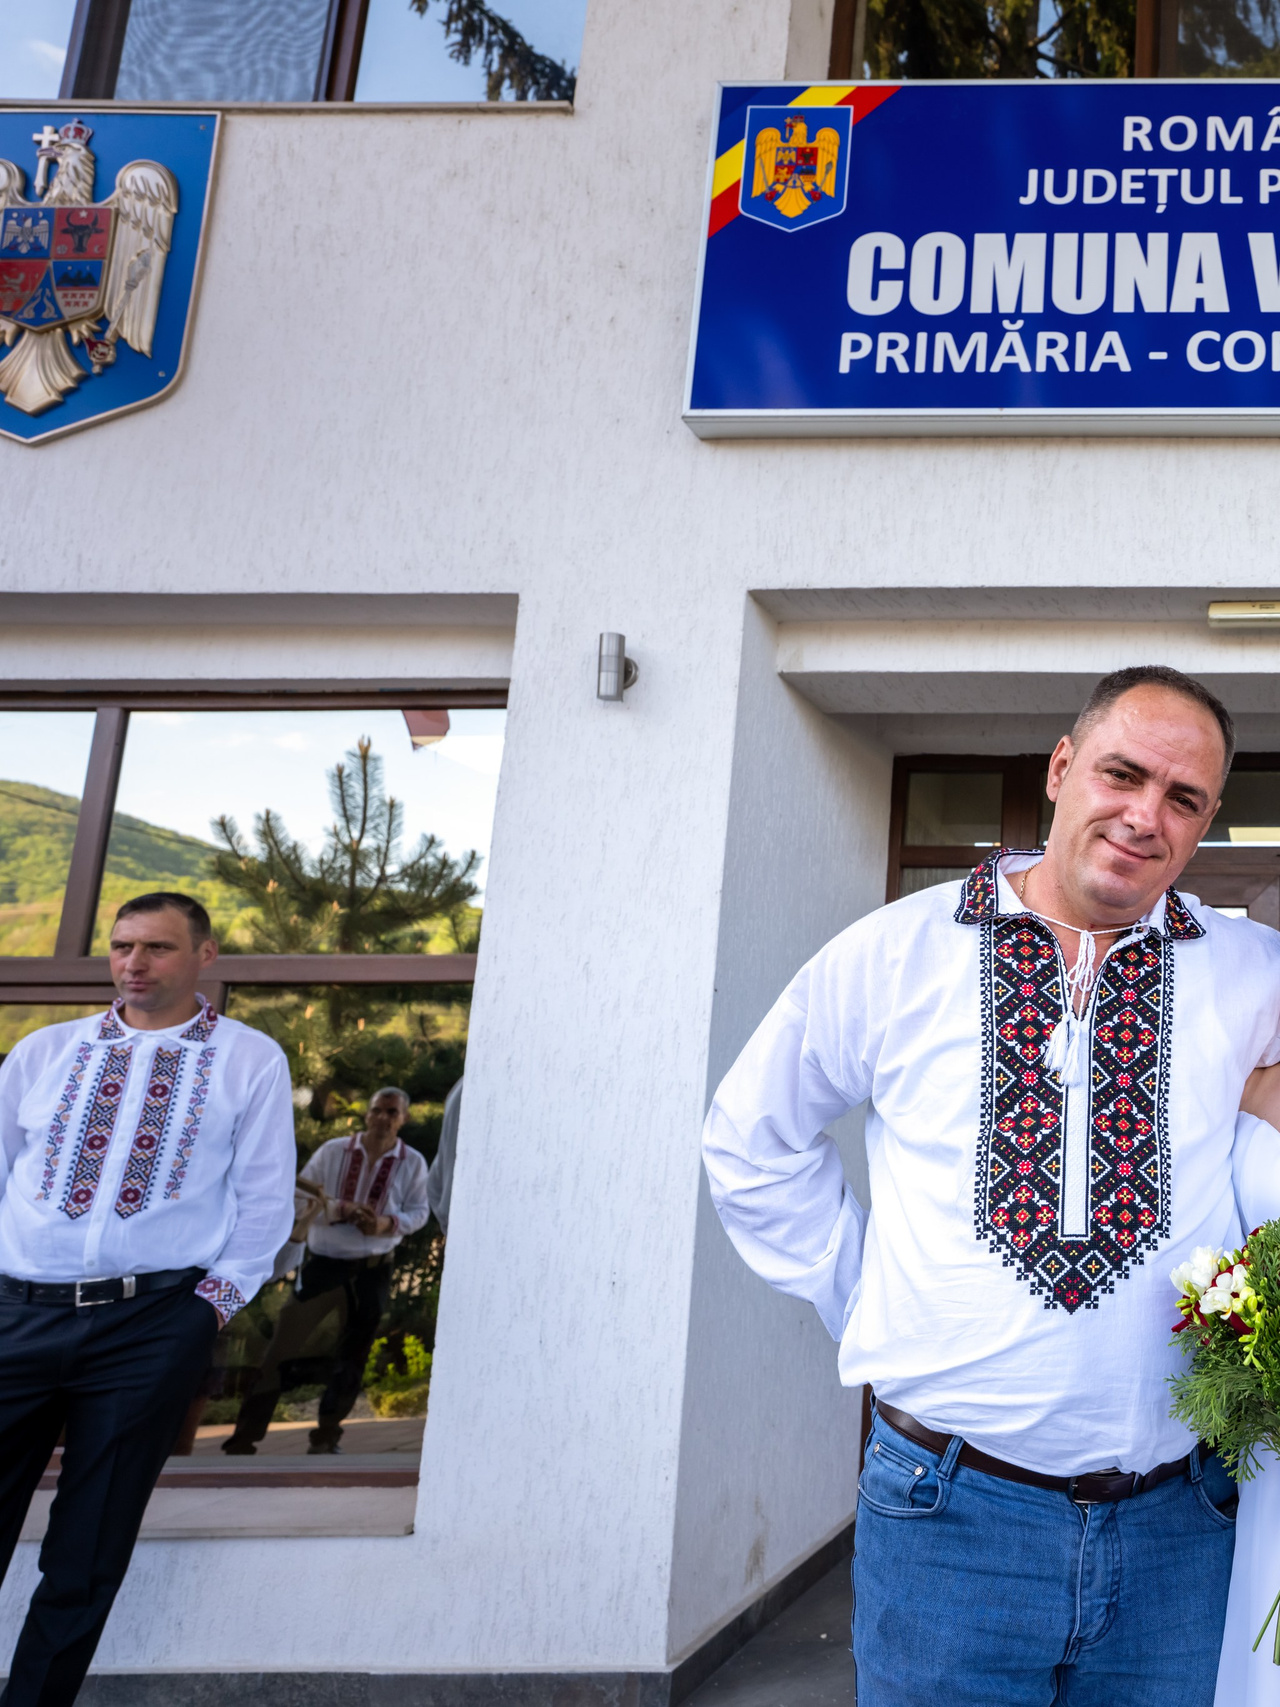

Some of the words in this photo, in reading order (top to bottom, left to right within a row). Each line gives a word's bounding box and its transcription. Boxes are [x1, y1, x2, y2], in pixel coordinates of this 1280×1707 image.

[1018, 168, 1244, 214] JUDEȚUL
[846, 231, 1230, 316] COMUNA
[838, 319, 1132, 374] PRIMĂRIA
[1148, 351, 1168, 360] -
